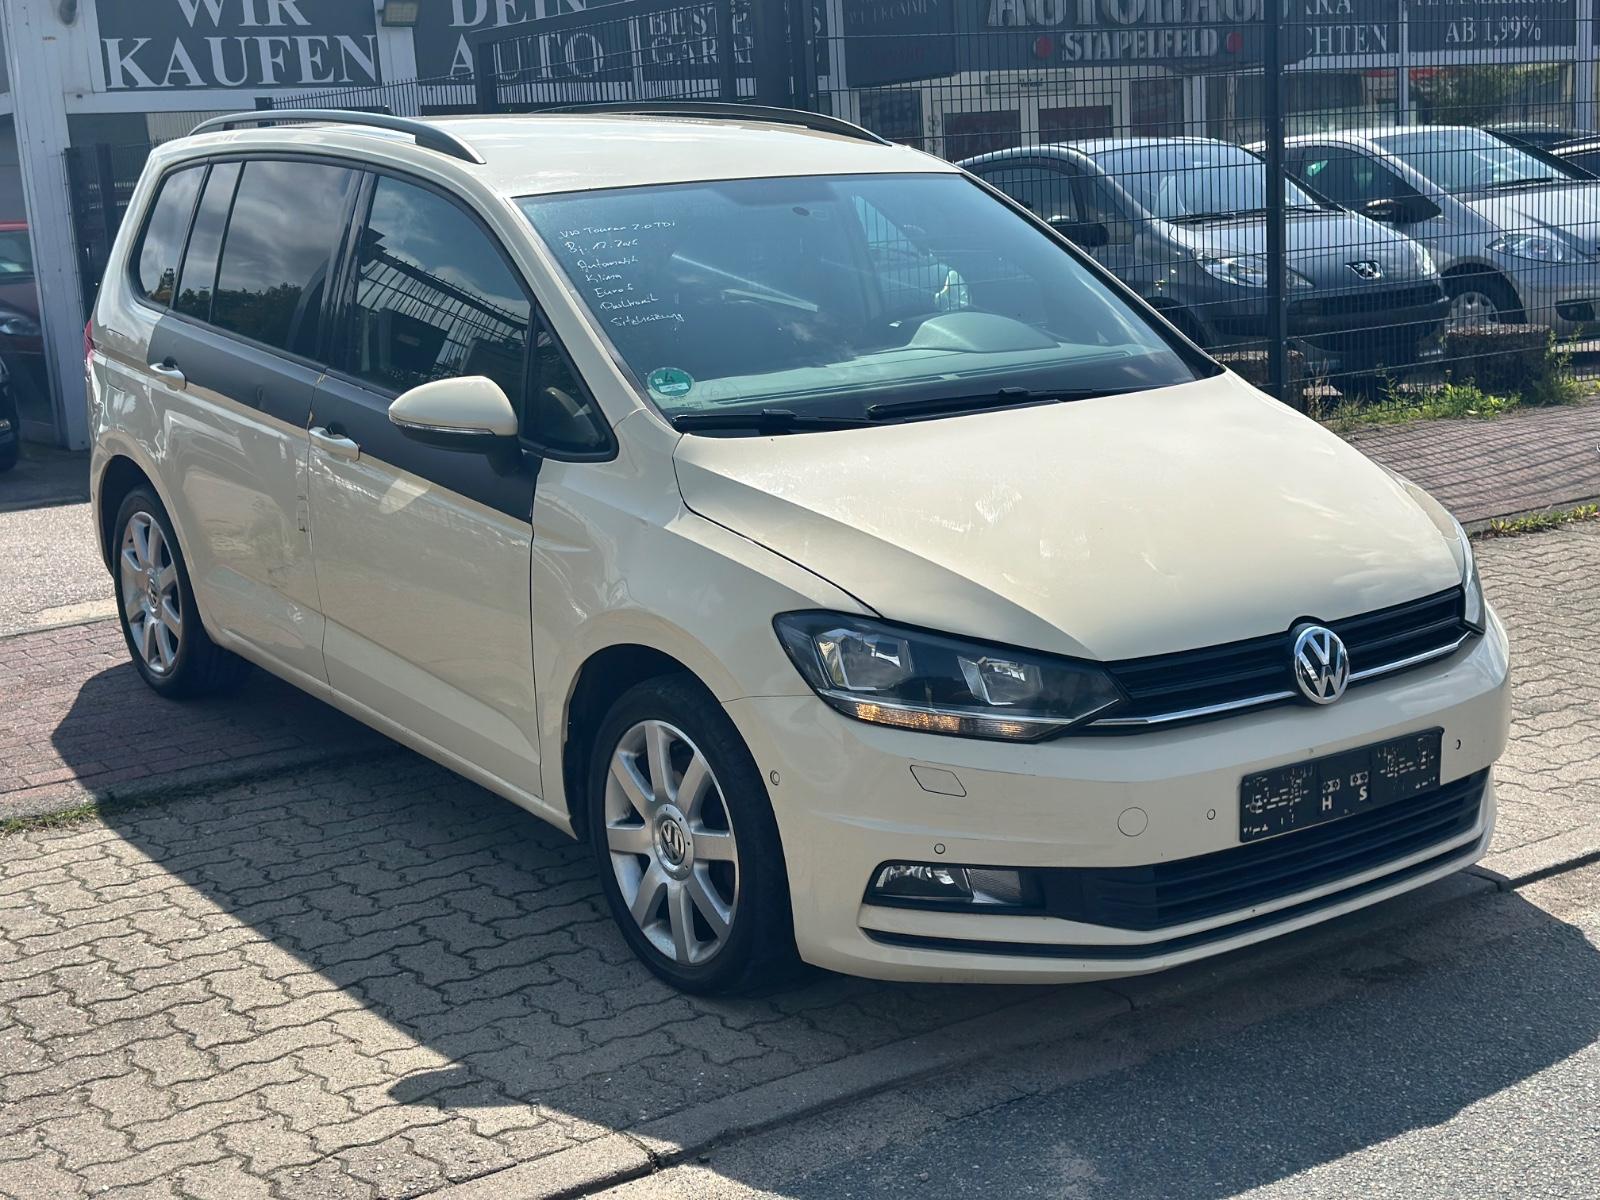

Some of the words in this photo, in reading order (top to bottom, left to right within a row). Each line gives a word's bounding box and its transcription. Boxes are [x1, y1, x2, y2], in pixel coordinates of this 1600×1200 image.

[177, 0, 312, 28] WIR
[1062, 28, 1219, 61] STAPELFELD
[1445, 18, 1476, 43] AB
[1484, 15, 1541, 46] 1,99%
[102, 35, 379, 89] KAUFEN
[448, 32, 605, 81] AUTO
[559, 230, 580, 238] VW
[583, 226, 626, 235] Touran
[585, 274, 622, 283] Klima
[594, 287, 624, 299] Euro
